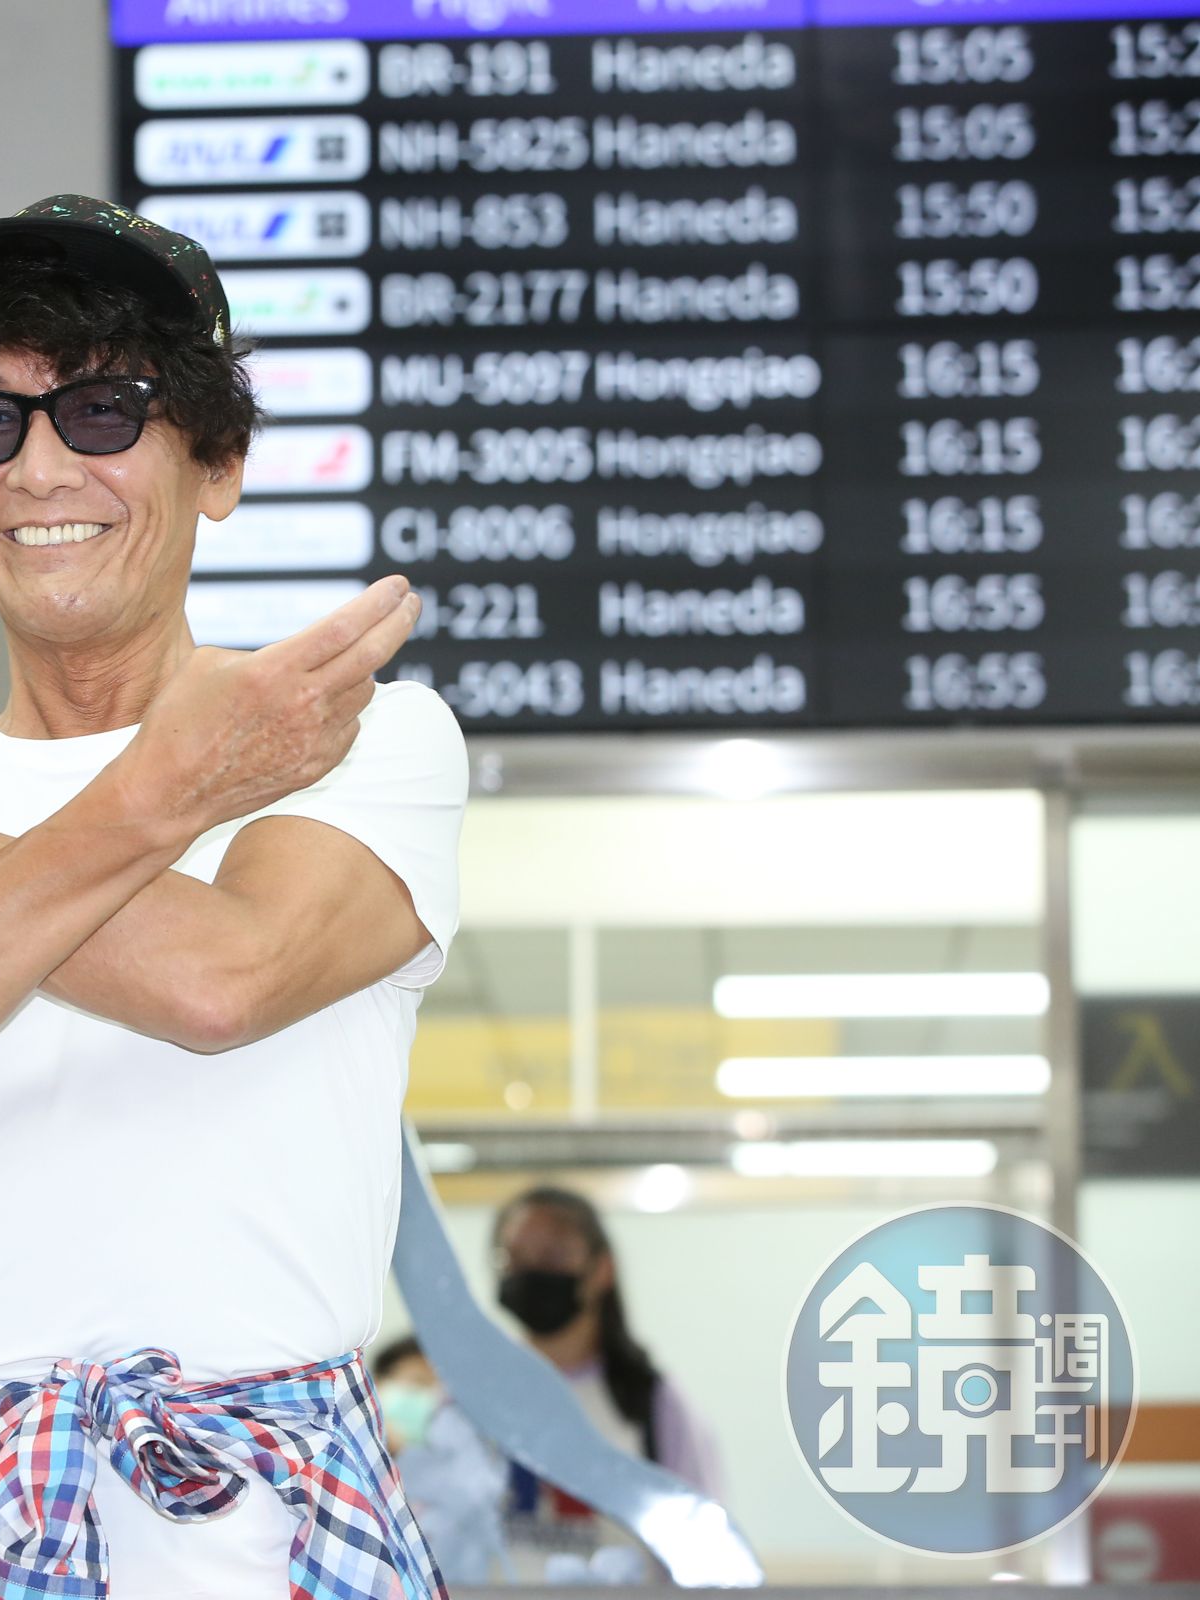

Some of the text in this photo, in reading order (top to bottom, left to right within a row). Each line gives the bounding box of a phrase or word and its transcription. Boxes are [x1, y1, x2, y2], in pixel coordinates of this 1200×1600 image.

[378, 40, 556, 98] BR-191
[591, 31, 796, 93] Haneda
[894, 26, 1033, 85] 15:05
[593, 110, 797, 169] Haneda
[895, 104, 1034, 162] 15:05
[594, 187, 798, 246] Haneda
[896, 180, 1038, 239] 15:50
[381, 269, 588, 327] BR-2177
[595, 263, 799, 323] Haneda
[897, 257, 1038, 316] 15:50
[595, 345, 821, 412] Hongqiao
[899, 339, 1040, 398] 16:15
[597, 424, 822, 489] Hongqiao
[900, 417, 1041, 476] 16:15
[597, 502, 824, 567] Hongqiao
[901, 495, 1043, 554] 16:15
[599, 576, 805, 637] Haneda
[902, 573, 1044, 632] 16:55
[1121, 569, 1200, 628] 16:
[599, 654, 806, 715] Haneda
[904, 651, 1047, 711] 16:55
[1122, 647, 1200, 707] 16:
